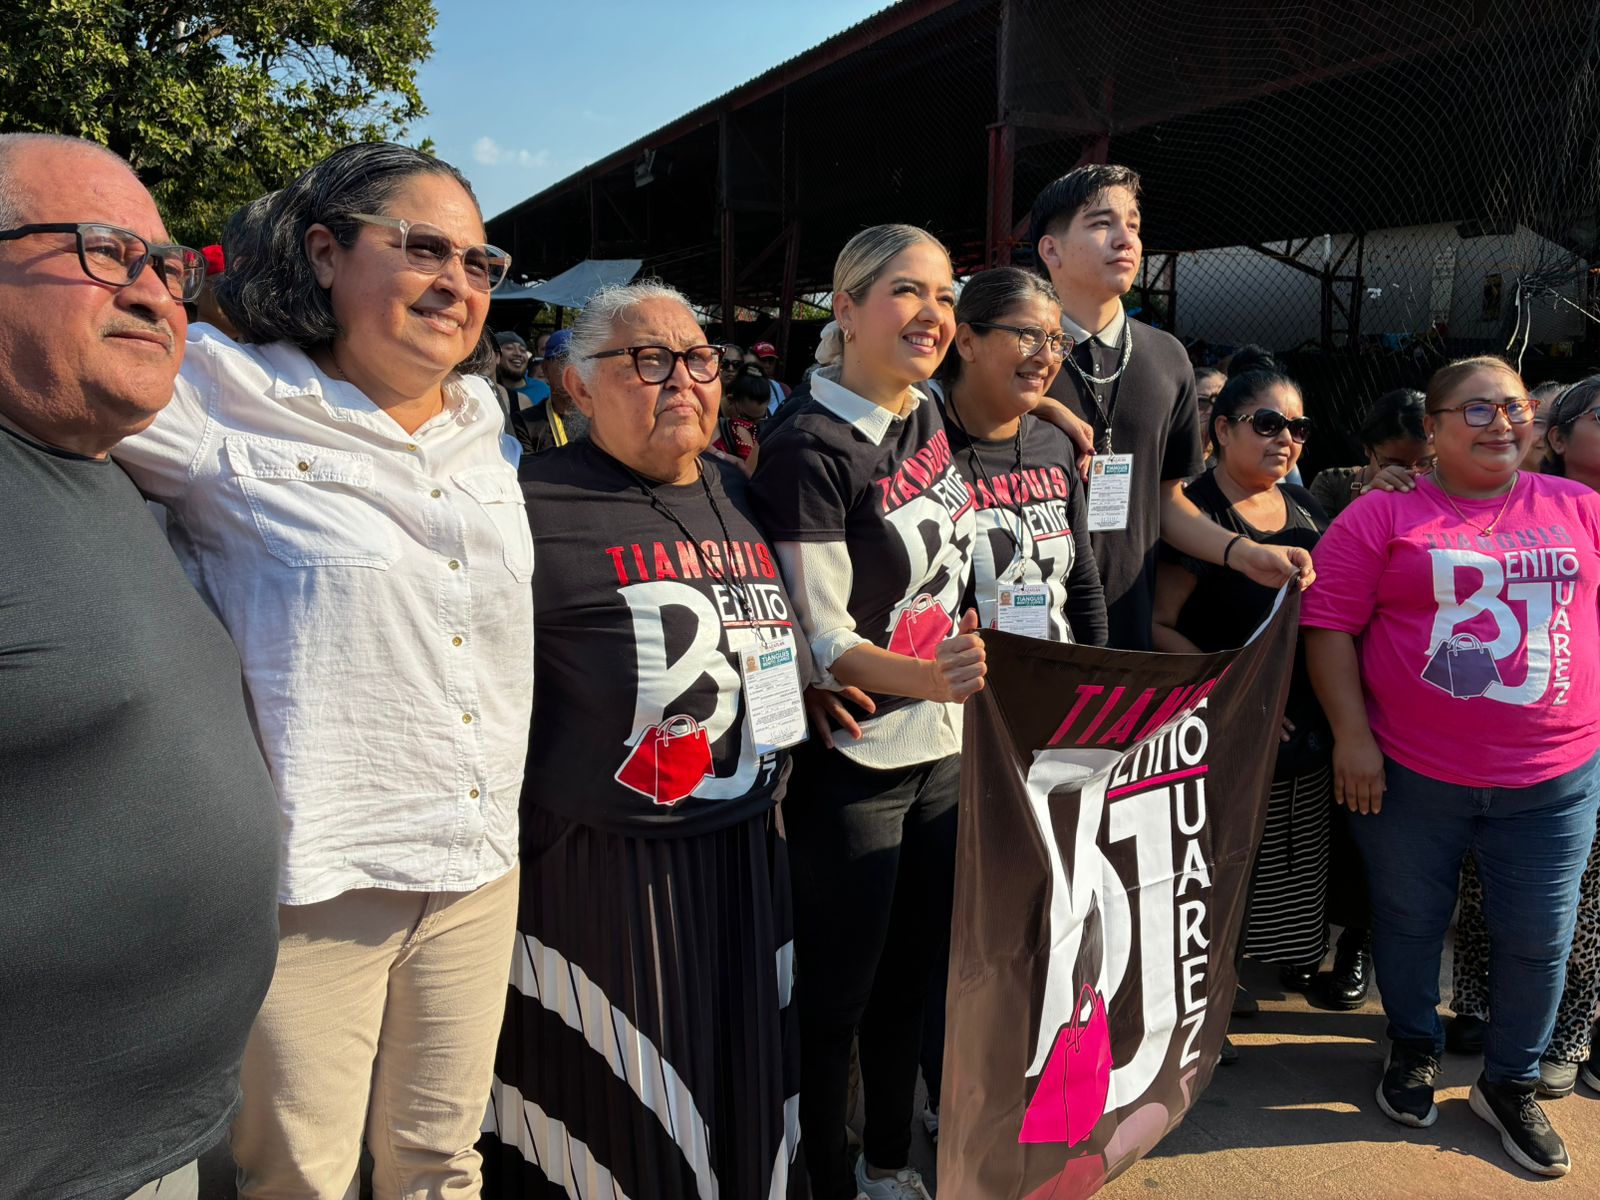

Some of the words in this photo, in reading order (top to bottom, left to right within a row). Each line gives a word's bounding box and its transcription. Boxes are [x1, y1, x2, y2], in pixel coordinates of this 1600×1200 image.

[965, 466, 1068, 510] IANGUIS
[1424, 525, 1571, 550] TIANGUIS
[606, 540, 776, 585] TIANGUIS
